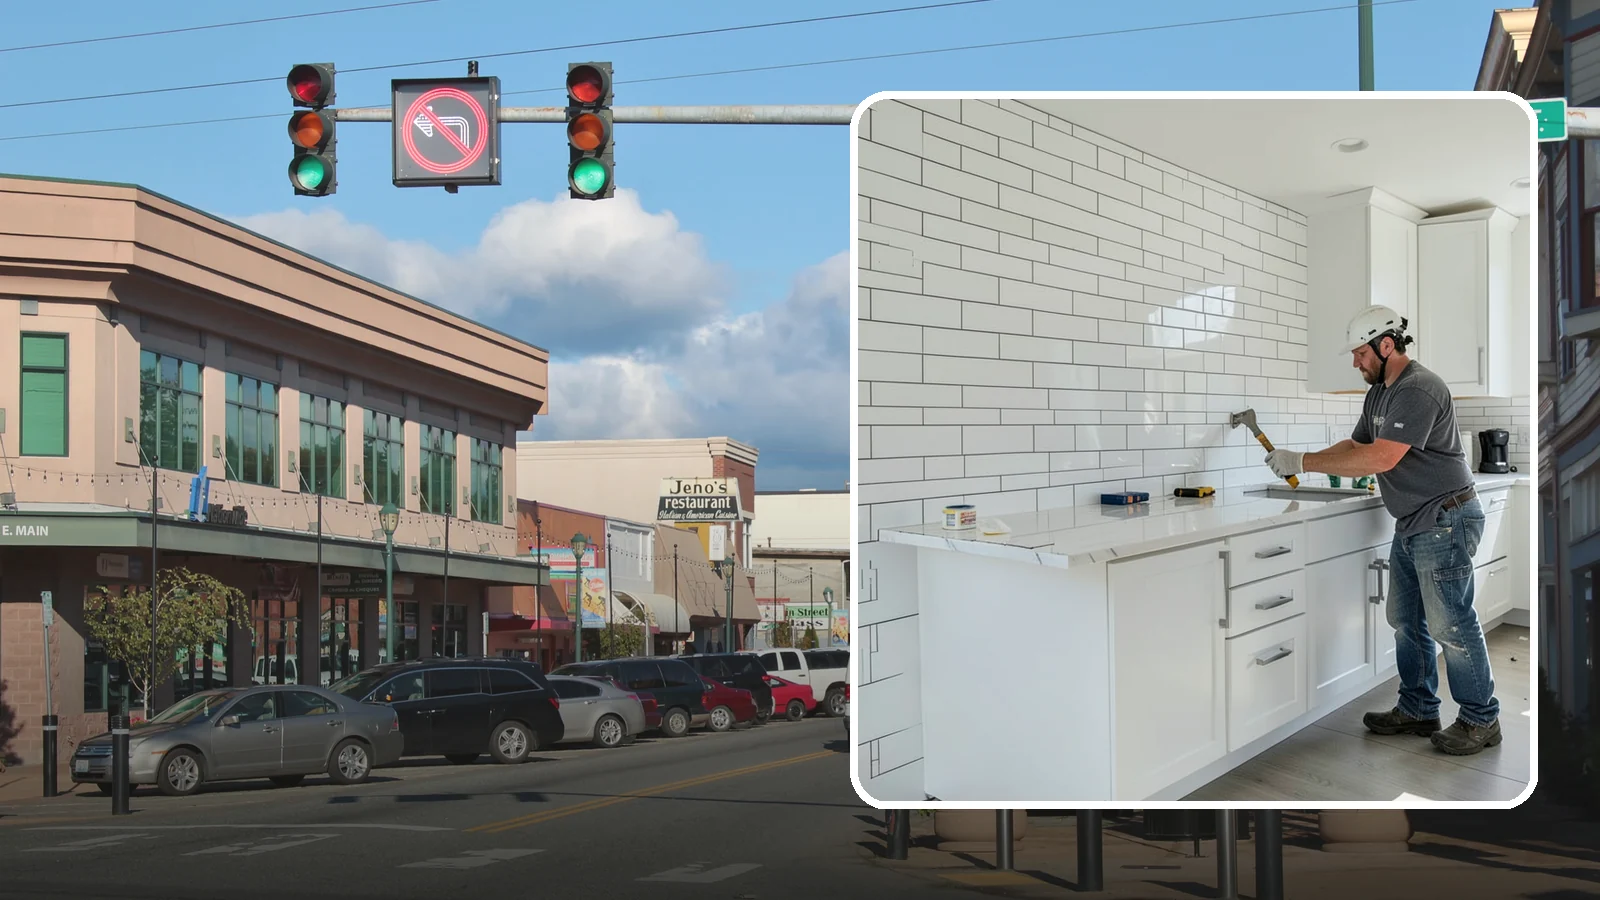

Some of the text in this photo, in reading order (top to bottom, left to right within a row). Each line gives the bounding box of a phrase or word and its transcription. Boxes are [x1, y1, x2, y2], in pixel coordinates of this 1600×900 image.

[670, 480, 728, 494] Jeno's
[665, 497, 731, 509] restaurant
[658, 510, 682, 520] Italian
[686, 510, 715, 520] American
[715, 509, 738, 519] Cuisine
[2, 525, 49, 536] E. MAIN
[797, 608, 828, 616] Street
